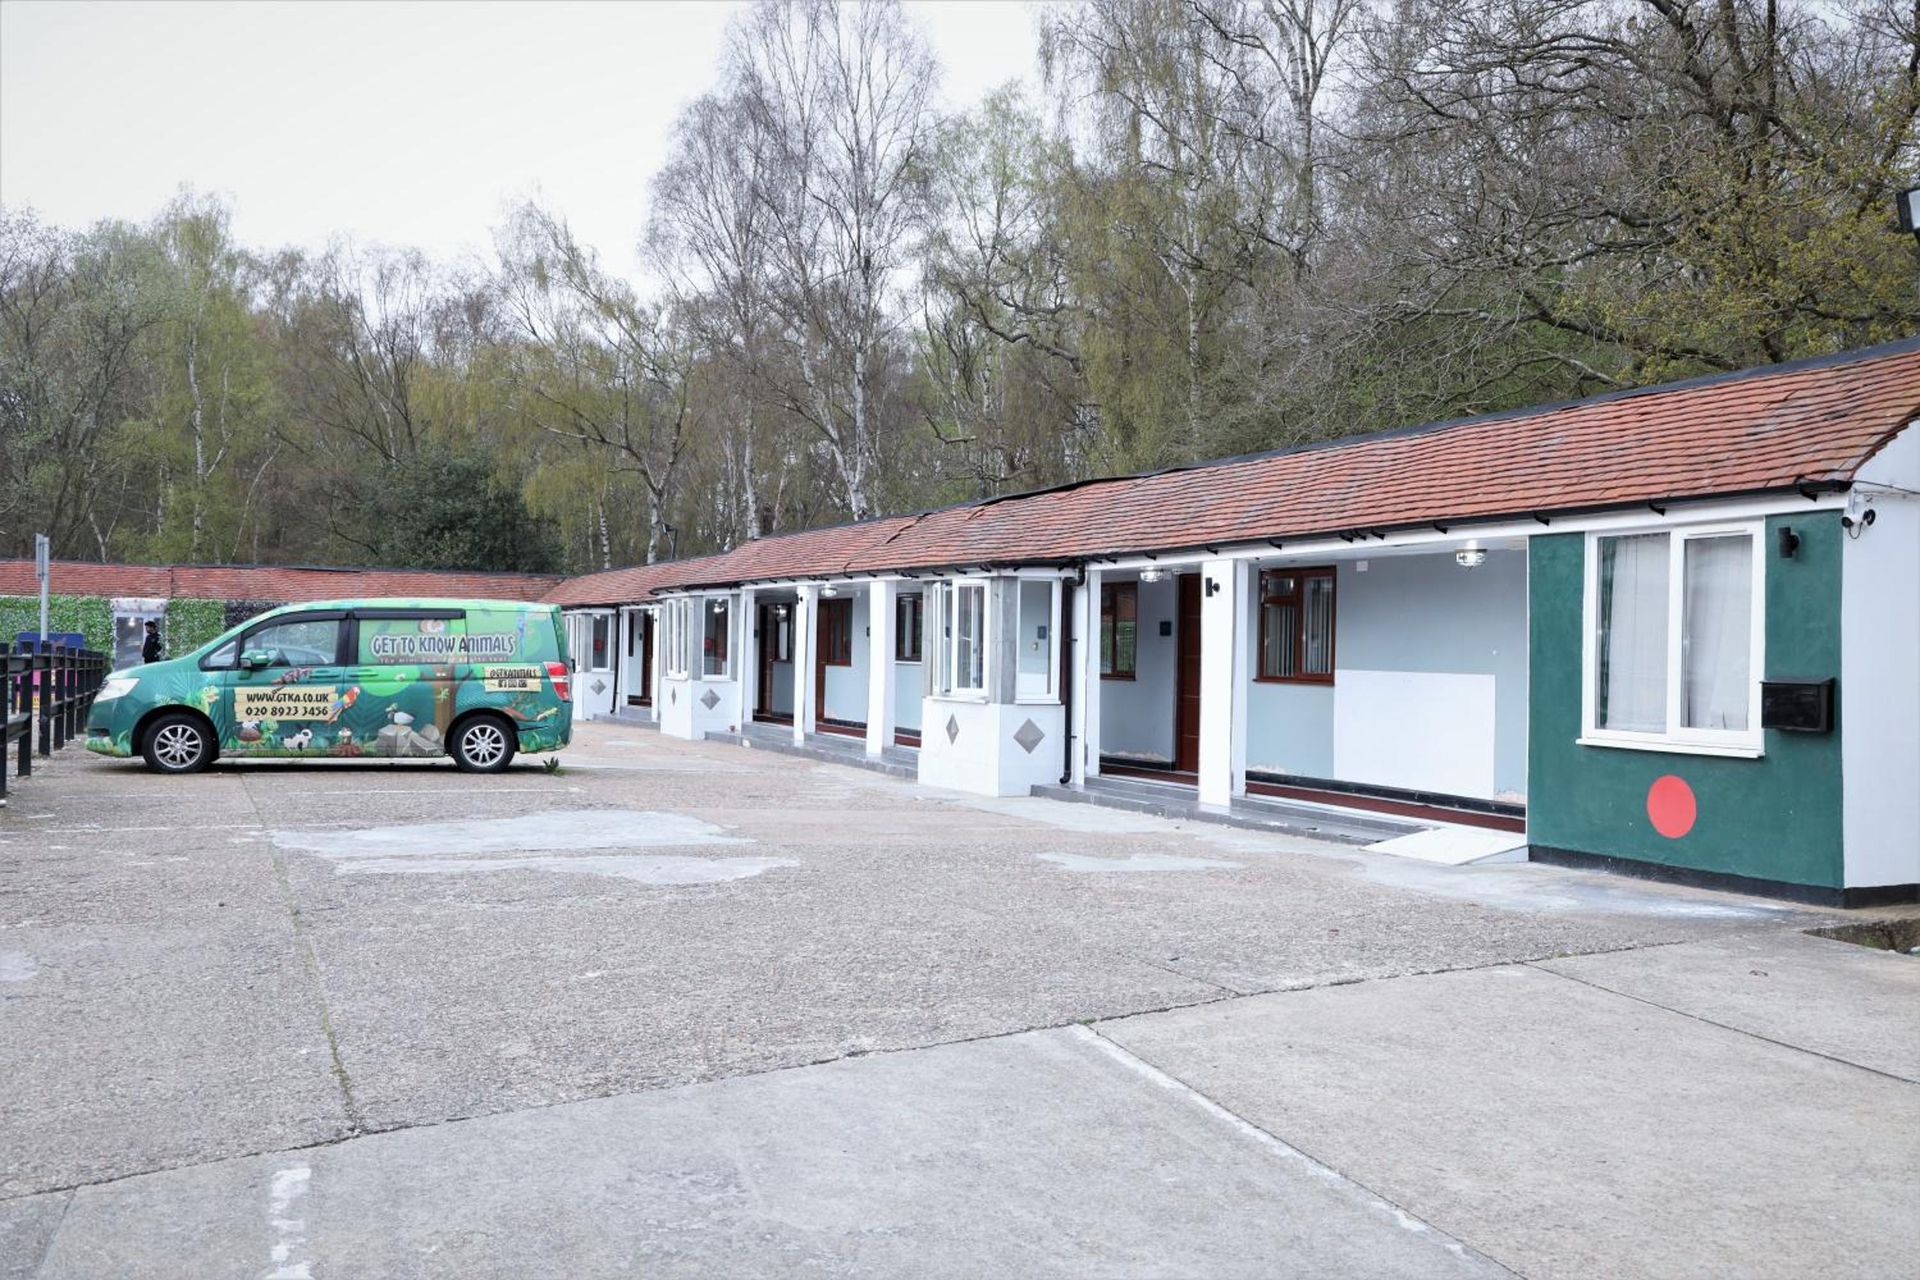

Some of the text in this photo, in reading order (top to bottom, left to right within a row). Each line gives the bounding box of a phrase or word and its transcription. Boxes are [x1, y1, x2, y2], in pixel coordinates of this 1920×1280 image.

[373, 635, 514, 655] GET TO KNOW ANIMALS
[246, 692, 329, 703] WWW.GTKA.CO.UK
[245, 706, 329, 717] 020 8923 3456
